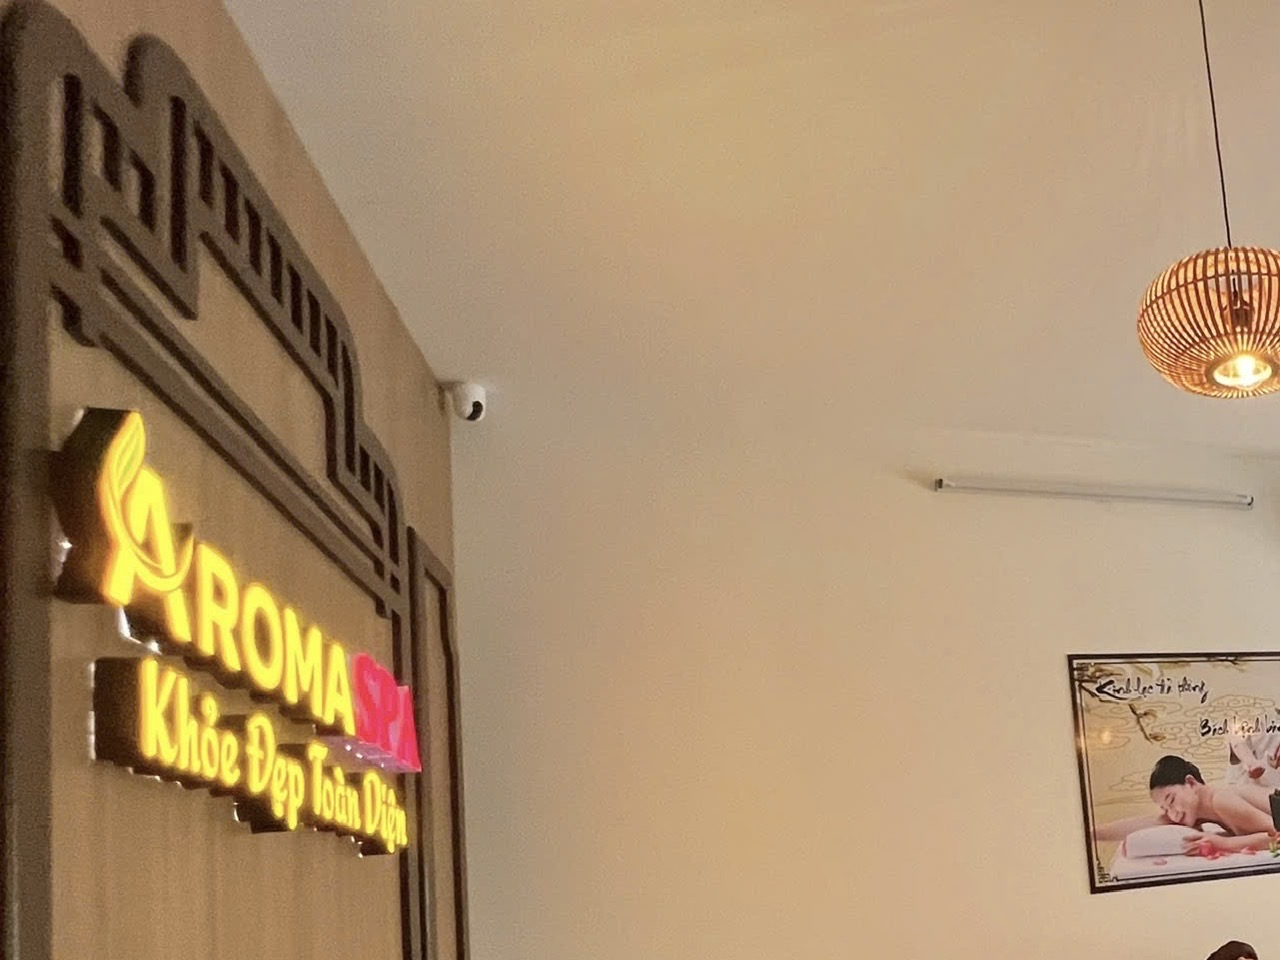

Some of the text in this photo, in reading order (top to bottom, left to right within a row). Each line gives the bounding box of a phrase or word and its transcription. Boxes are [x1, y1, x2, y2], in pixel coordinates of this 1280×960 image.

[246, 713, 306, 830] Đẹp
[309, 742, 361, 830] Toàn
[363, 769, 408, 853] Diện
